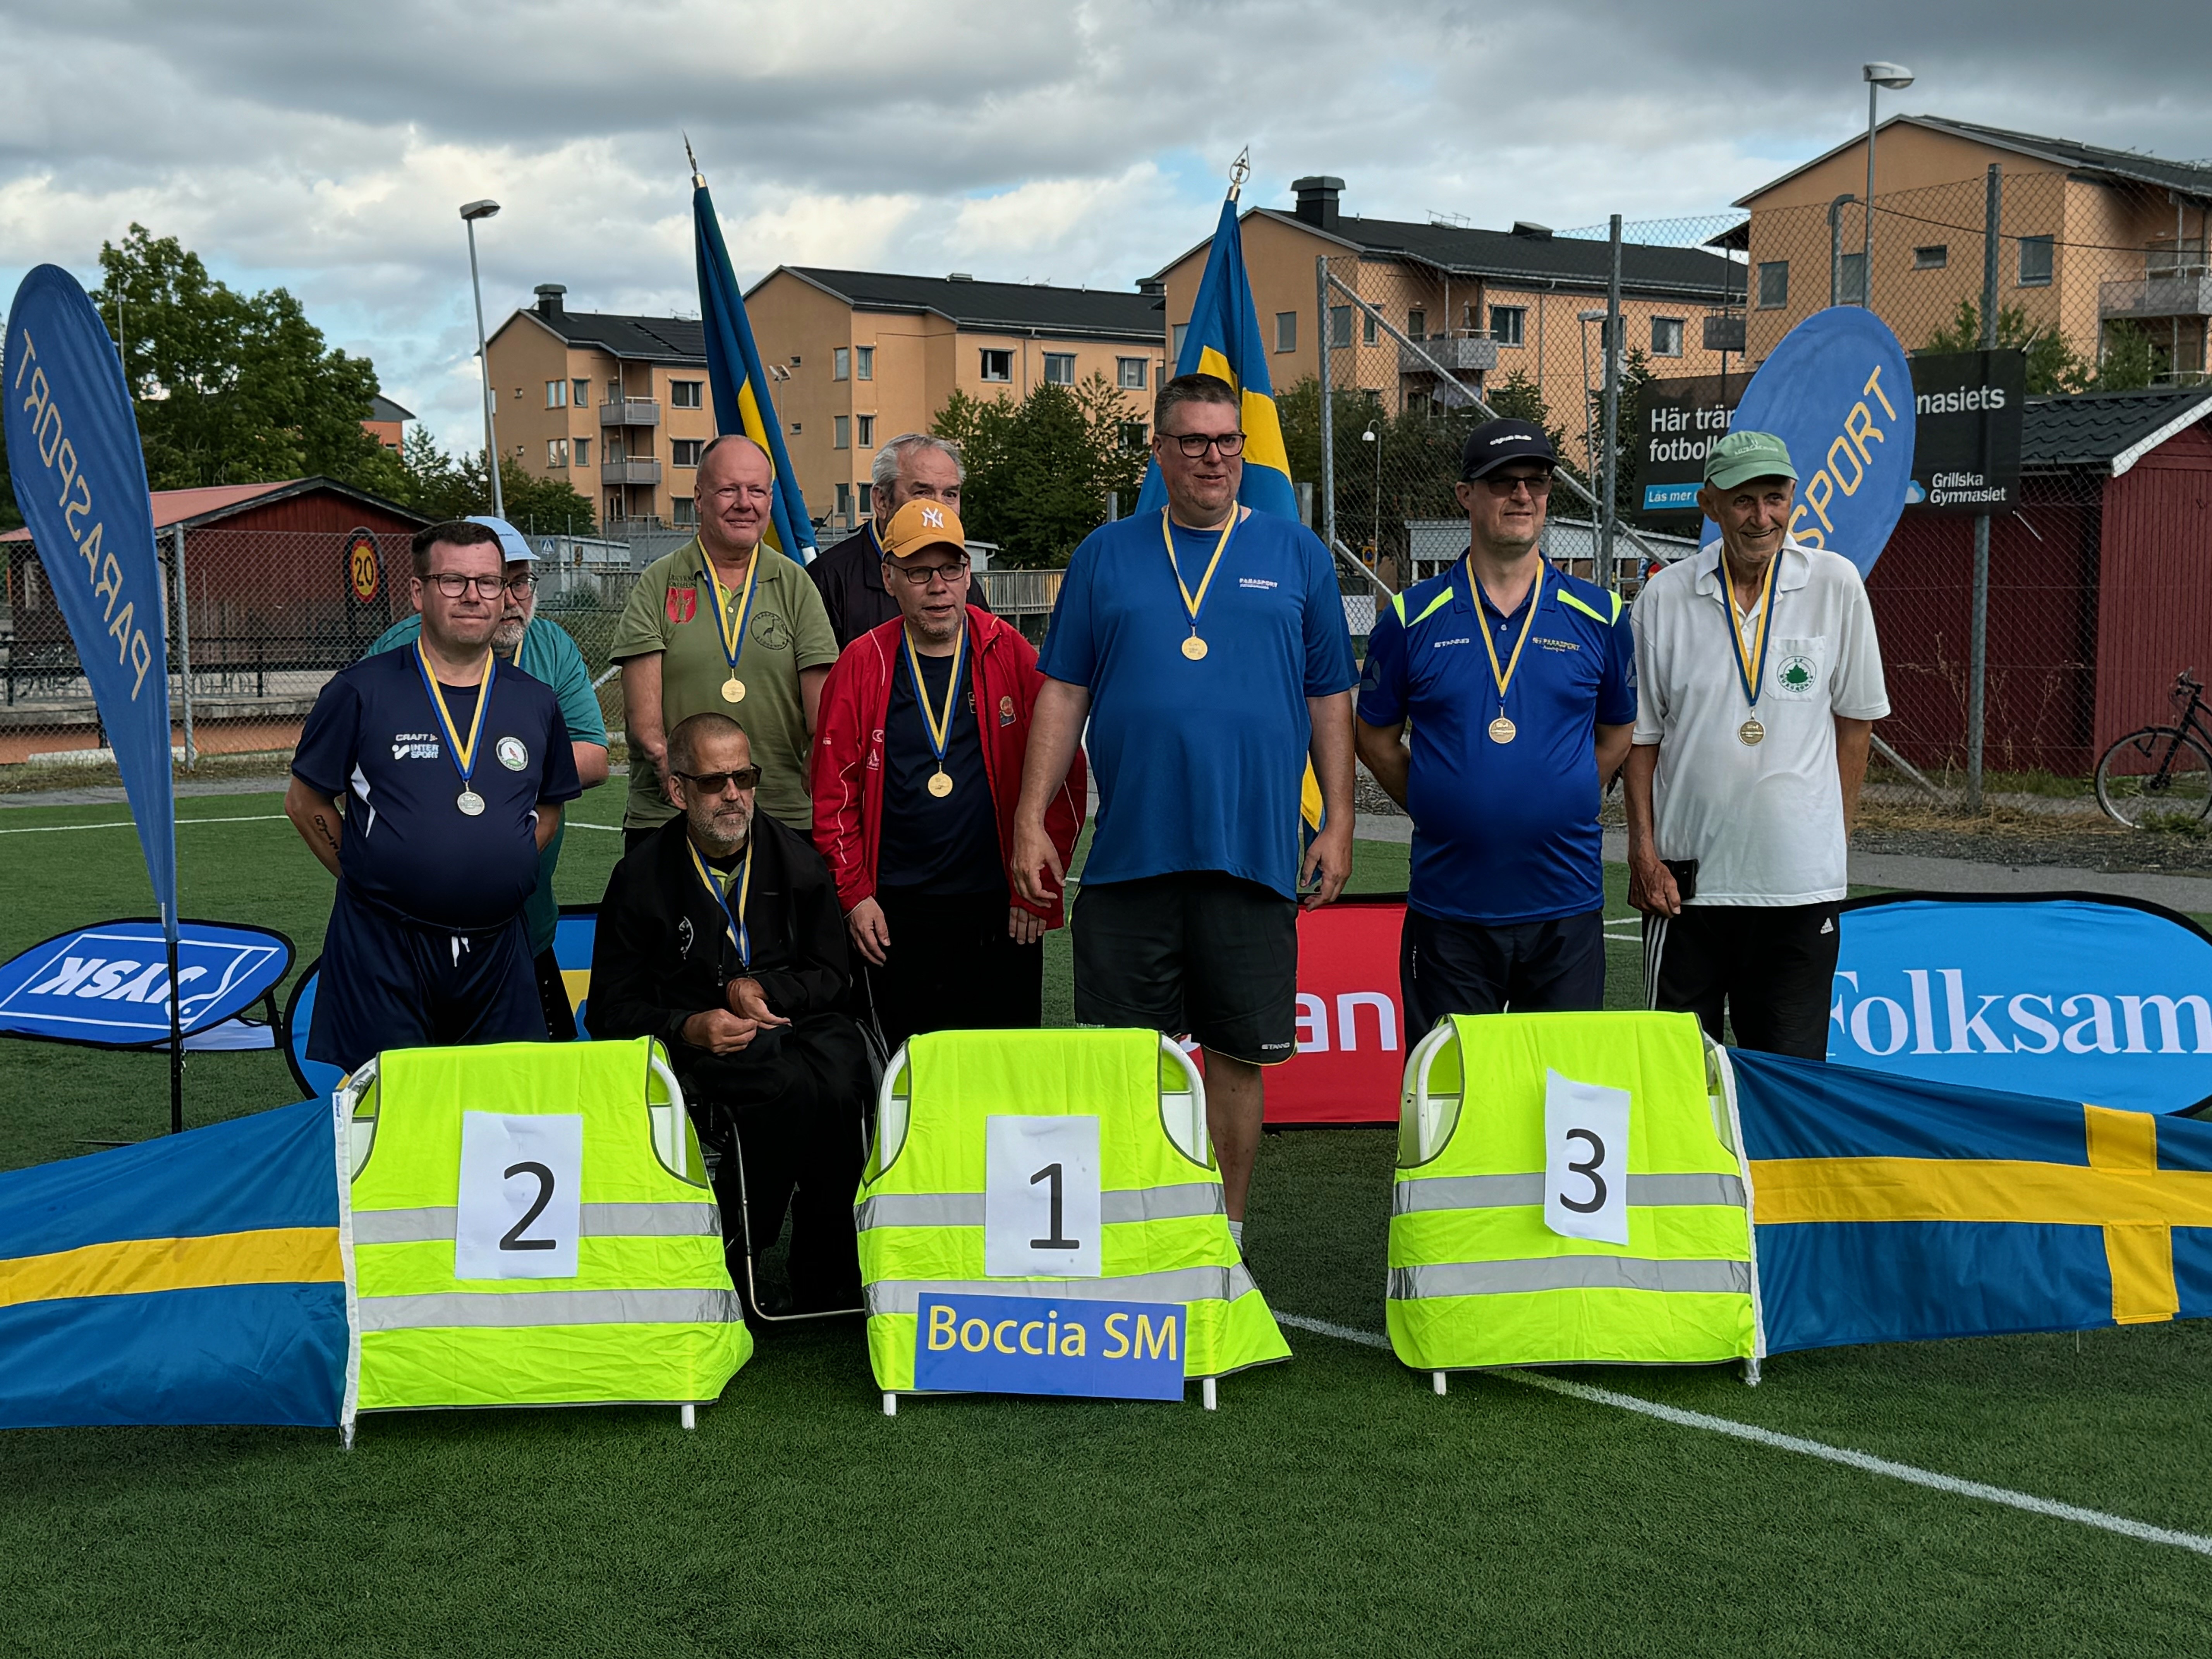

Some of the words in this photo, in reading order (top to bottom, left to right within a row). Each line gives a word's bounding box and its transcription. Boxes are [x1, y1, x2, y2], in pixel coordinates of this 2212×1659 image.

[1917, 385, 2005, 415] nasiets
[1651, 407, 1690, 432] Här
[1788, 365, 1896, 549] SPORT
[1932, 472, 1984, 488] Grillska
[1649, 490, 1667, 502] Läs
[1670, 492, 1692, 501] mer
[1930, 486, 2007, 506] Gymnasiet
[921, 507, 944, 528] NY
[355, 556, 374, 586] 20
[27, 957, 208, 1003] JYSK
[1560, 1128, 1607, 1213] 3
[500, 1161, 556, 1250] 2
[1030, 1163, 1080, 1249] 1
[928, 1305, 1085, 1357] Boccia
[1103, 1312, 1177, 1361] SM
